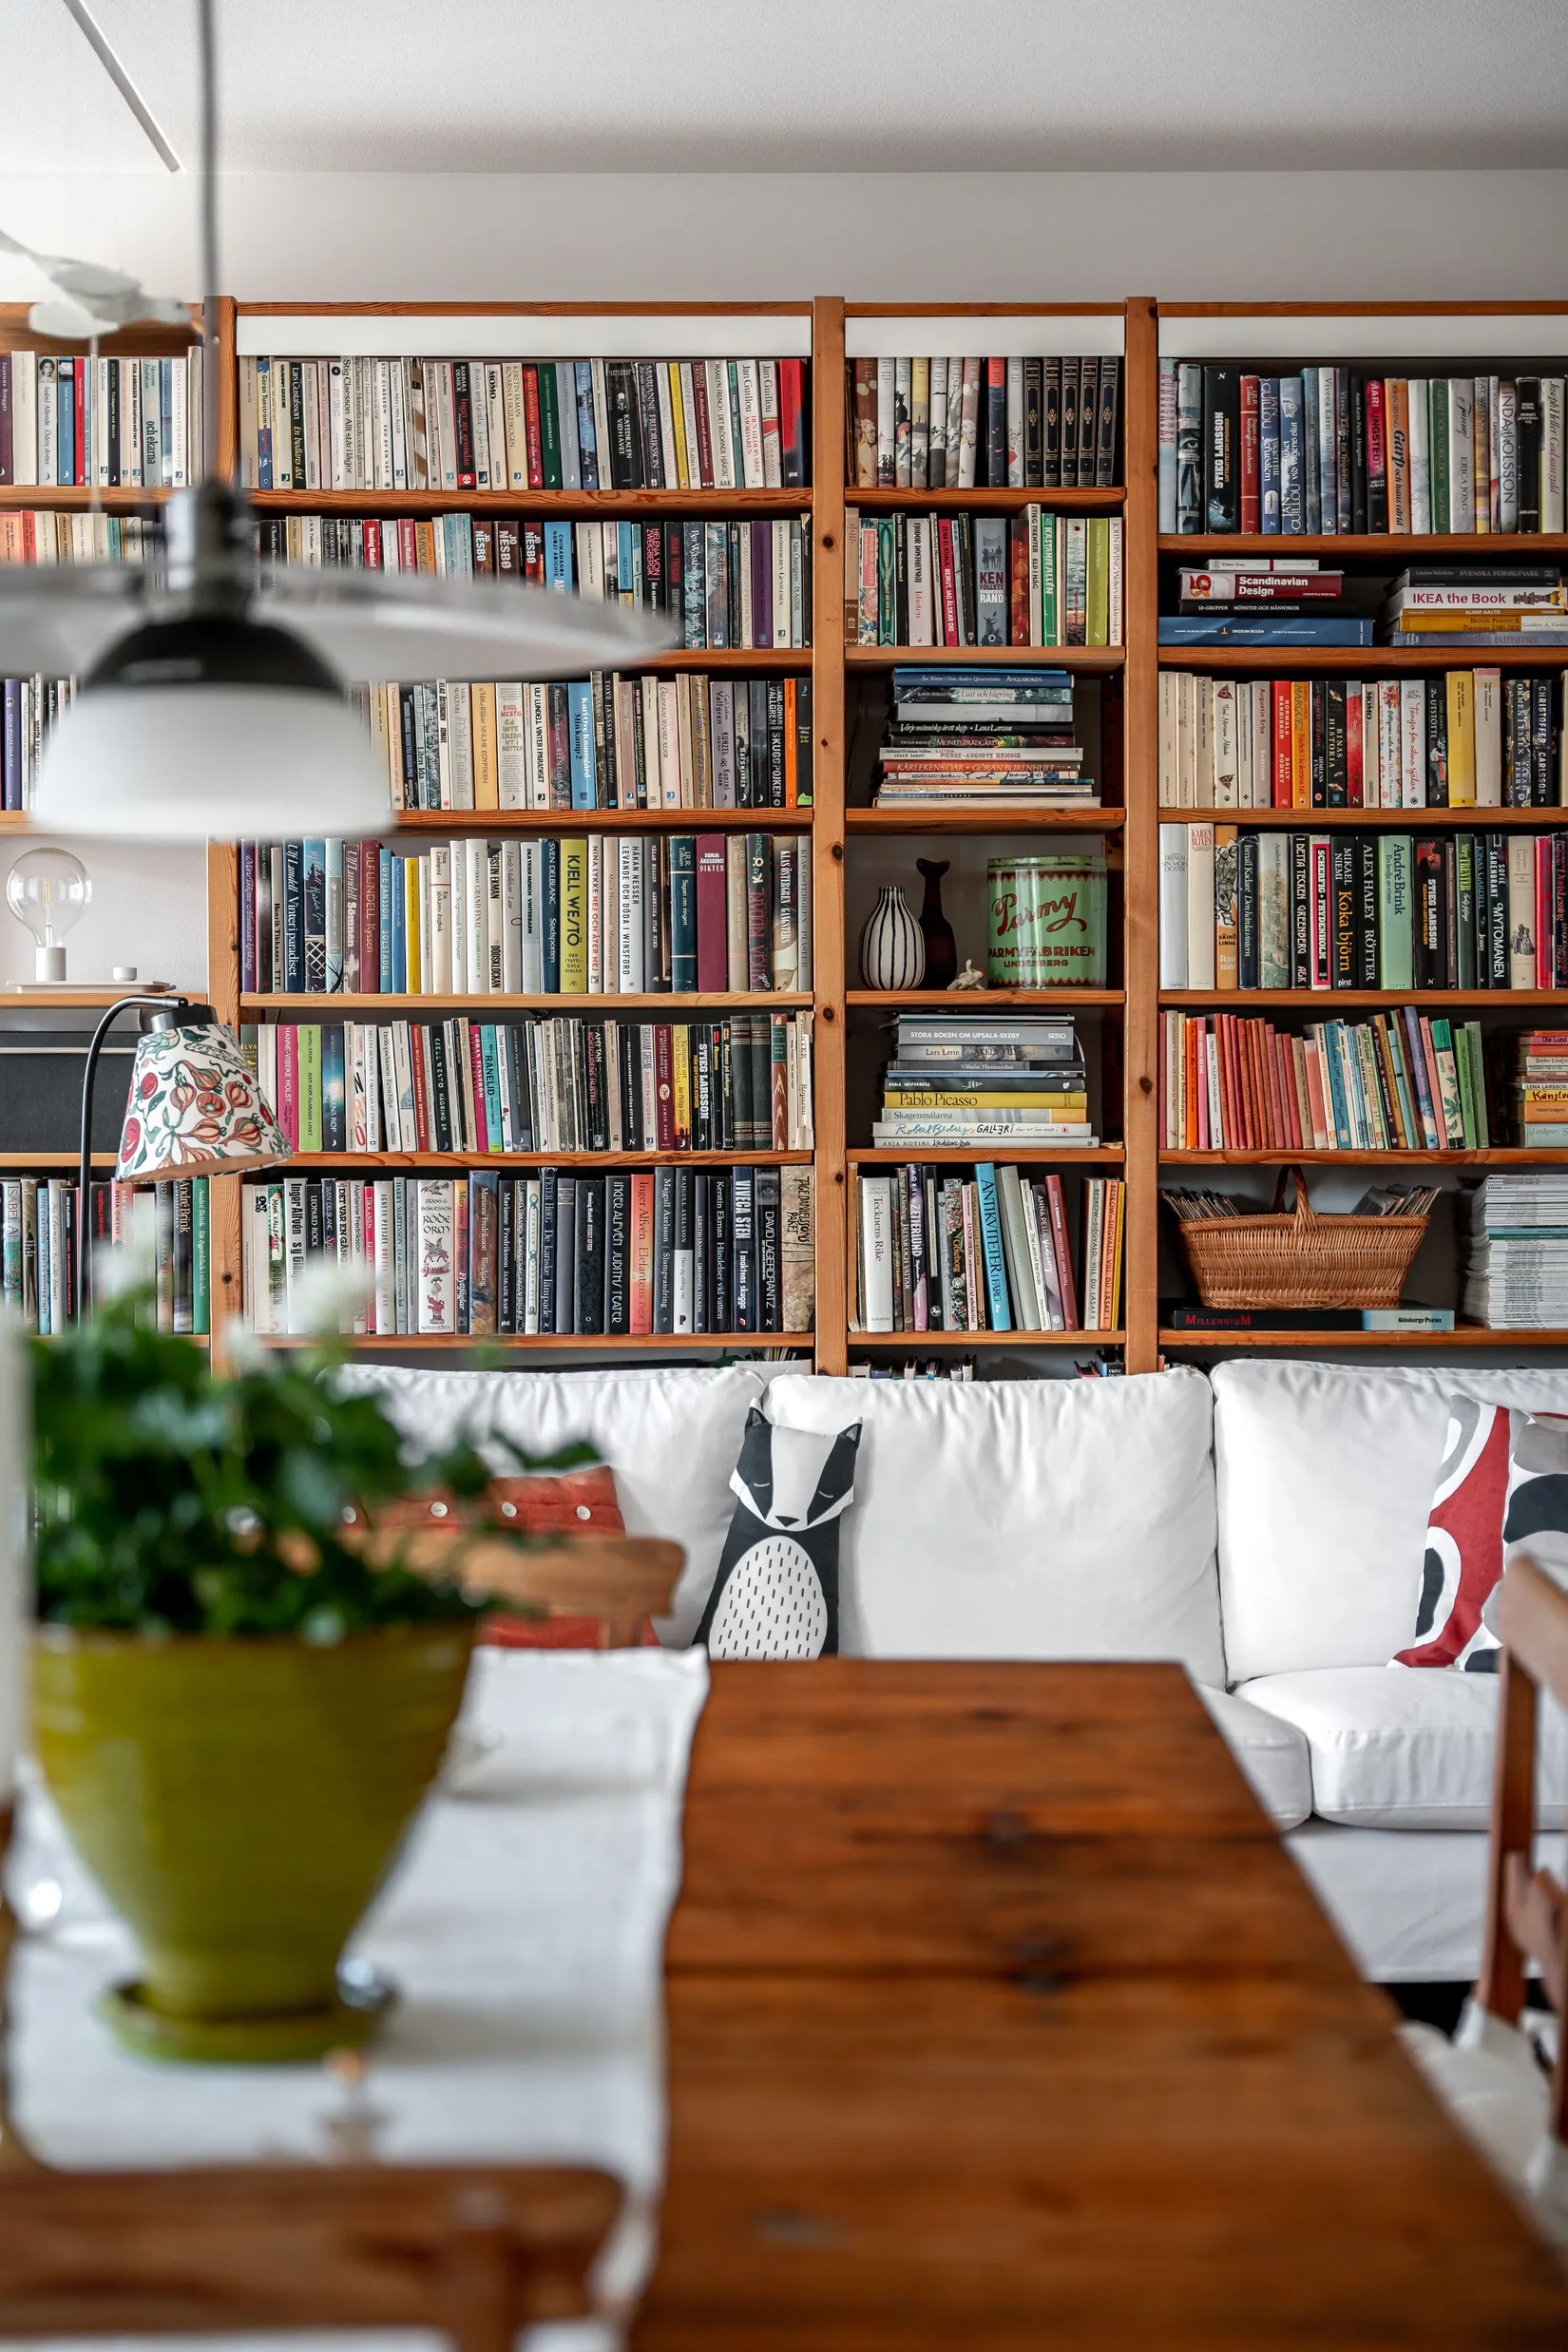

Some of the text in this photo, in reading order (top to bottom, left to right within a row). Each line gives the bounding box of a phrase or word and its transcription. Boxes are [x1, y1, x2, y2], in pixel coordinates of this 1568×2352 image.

[1160, 374, 1175, 443] KUNGSGATAN
[147, 421, 158, 464] och ekarna
[1391, 430, 1405, 468] Garp
[345, 453, 354, 473] lågor
[1503, 443, 1515, 504] OLSSON
[500, 531, 511, 568] NESBØ
[509, 535, 517, 544] JO
[980, 572, 1004, 583] KEN
[1045, 527, 1055, 594] KASTANJEALLÉN
[1239, 577, 1308, 585] Scandinavian
[1239, 586, 1273, 596] Design
[1413, 593, 1506, 603] IKEA the Book
[980, 595, 1004, 603] RAND
[988, 690, 1014, 699] fägring
[773, 733, 781, 796] SKUGGPOJKEN
[286, 844, 297, 859] Ulf
[1296, 844, 1305, 867] DETTA
[288, 859, 297, 892] Lundell
[1297, 870, 1306, 899] TECKEN
[1394, 844, 1405, 915] André Brink
[288, 896, 297, 927] Vinter
[567, 855, 583, 947] KJELL WESTÖ
[622, 904, 631, 924] DÖDA
[991, 892, 1087, 936] Parmy
[1364, 845, 1376, 981] ALEX HALEY RÖTTER
[1335, 891, 1352, 971] Koka björn
[1494, 903, 1503, 977] MYTOMANEN
[286, 933, 299, 976] paradiset
[988, 947, 1095, 958] PARMYFABRIKEN
[485, 1056, 494, 1095] RANELID
[699, 1043, 709, 1119] STIEG LARSSON
[894, 1110, 952, 1119] Skagenmålarna
[899, 1093, 977, 1106] Pablo Picasso
[180, 1181, 190, 1233] André Brink
[736, 1180, 751, 1214] VIVECA
[736, 1217, 751, 1238] STEN
[873, 1195, 884, 1261] Tecknens Rike
[982, 1179, 1002, 1273] ANTIKVITETER
[612, 1182, 624, 1323] INGER ALFVÉN JUDITHS TEATER
[737, 1286, 748, 1309] skugga
[991, 1279, 1002, 1302] FÄRG
